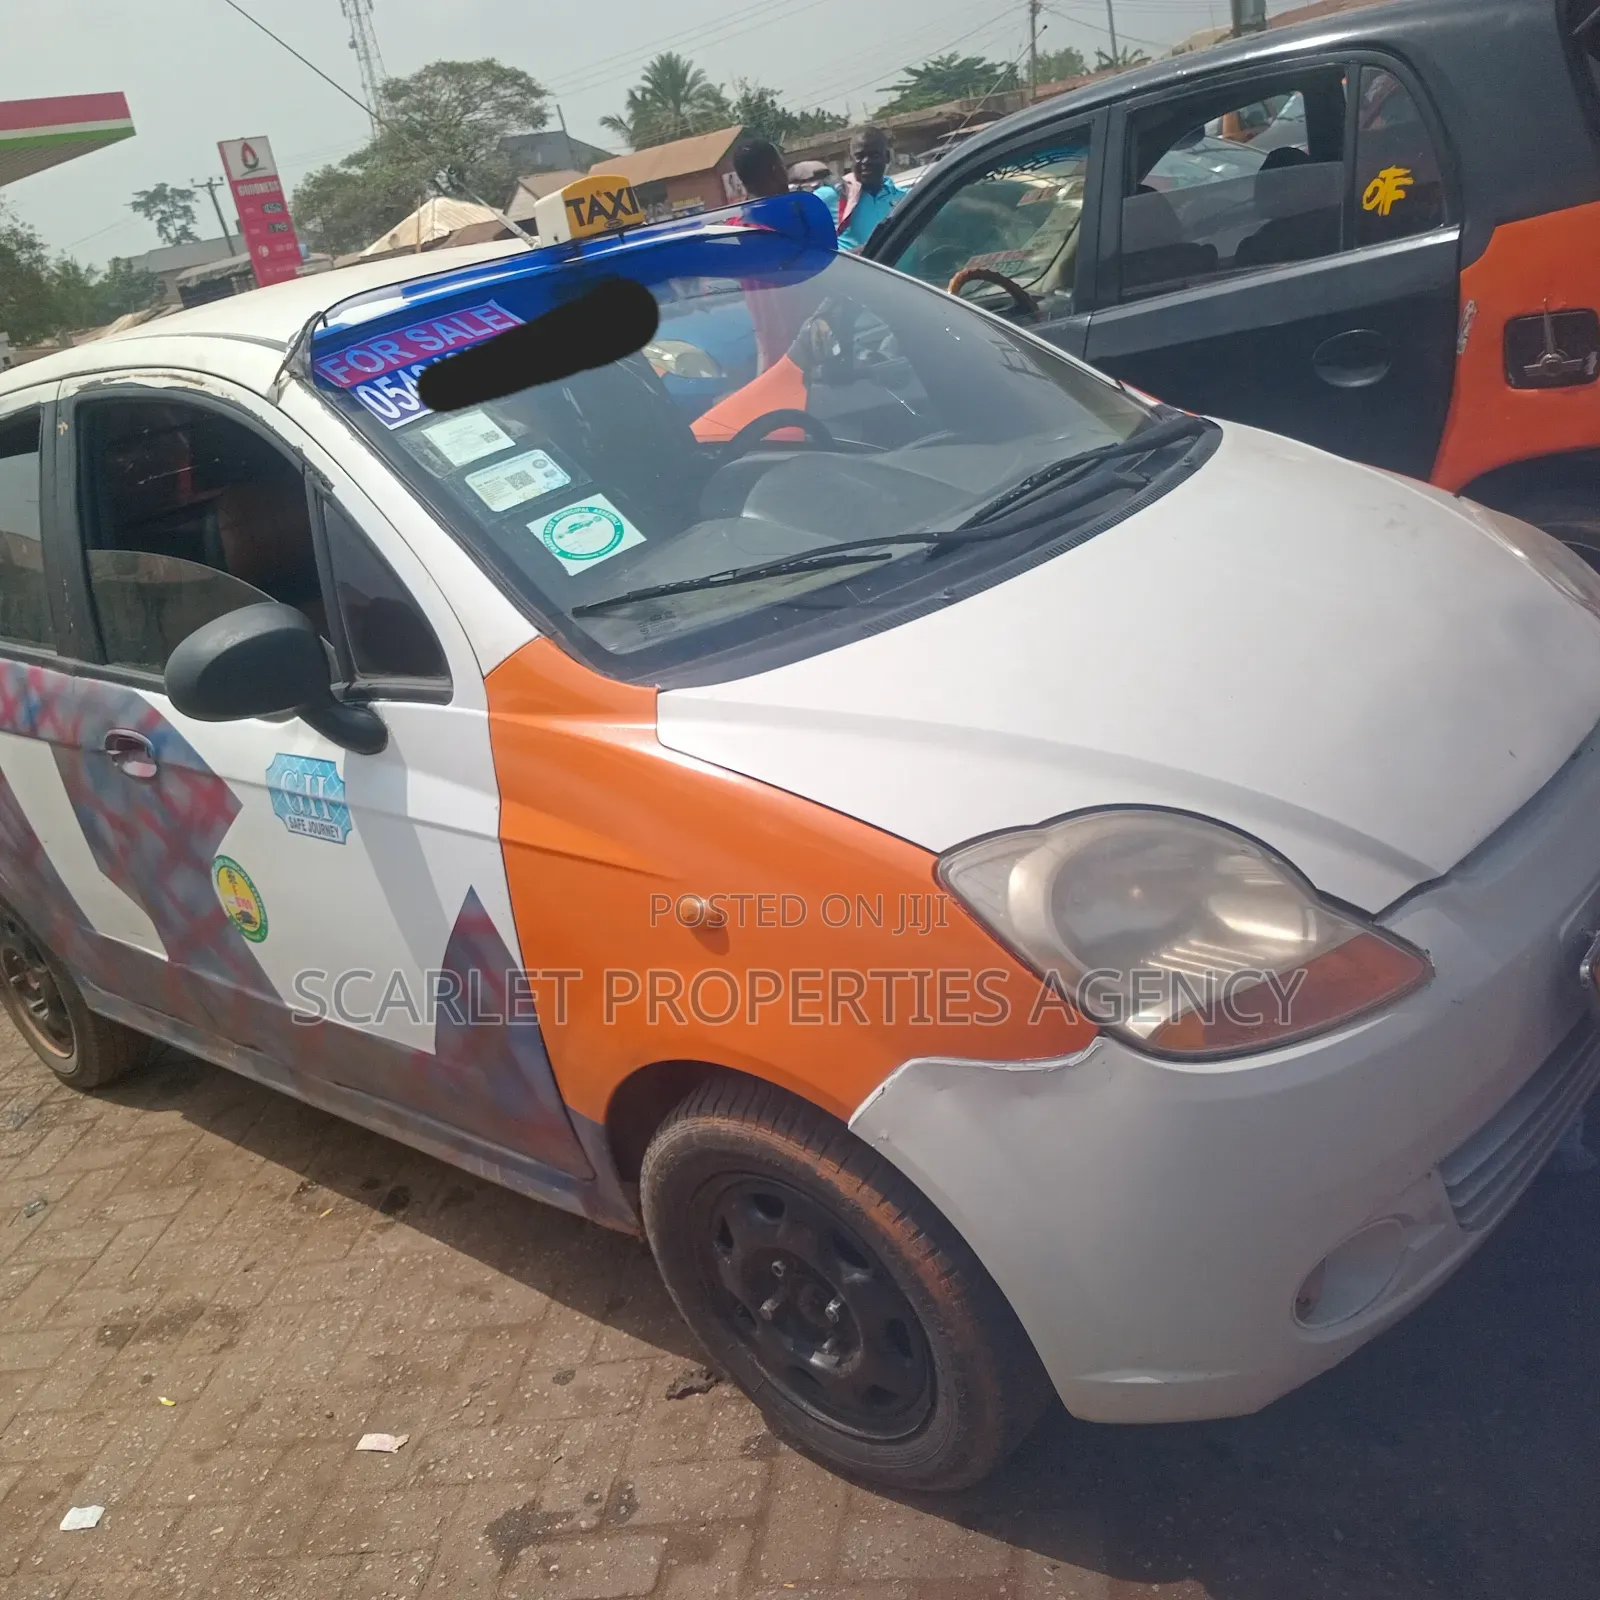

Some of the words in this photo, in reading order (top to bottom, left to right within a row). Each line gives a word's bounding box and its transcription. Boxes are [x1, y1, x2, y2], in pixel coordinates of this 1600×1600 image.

[564, 187, 639, 227] TAXI
[319, 339, 417, 384] FOR
[405, 306, 515, 351] SALE
[281, 770, 332, 819] GH
[288, 815, 307, 832] SAFE
[308, 820, 340, 839] JOURNEY
